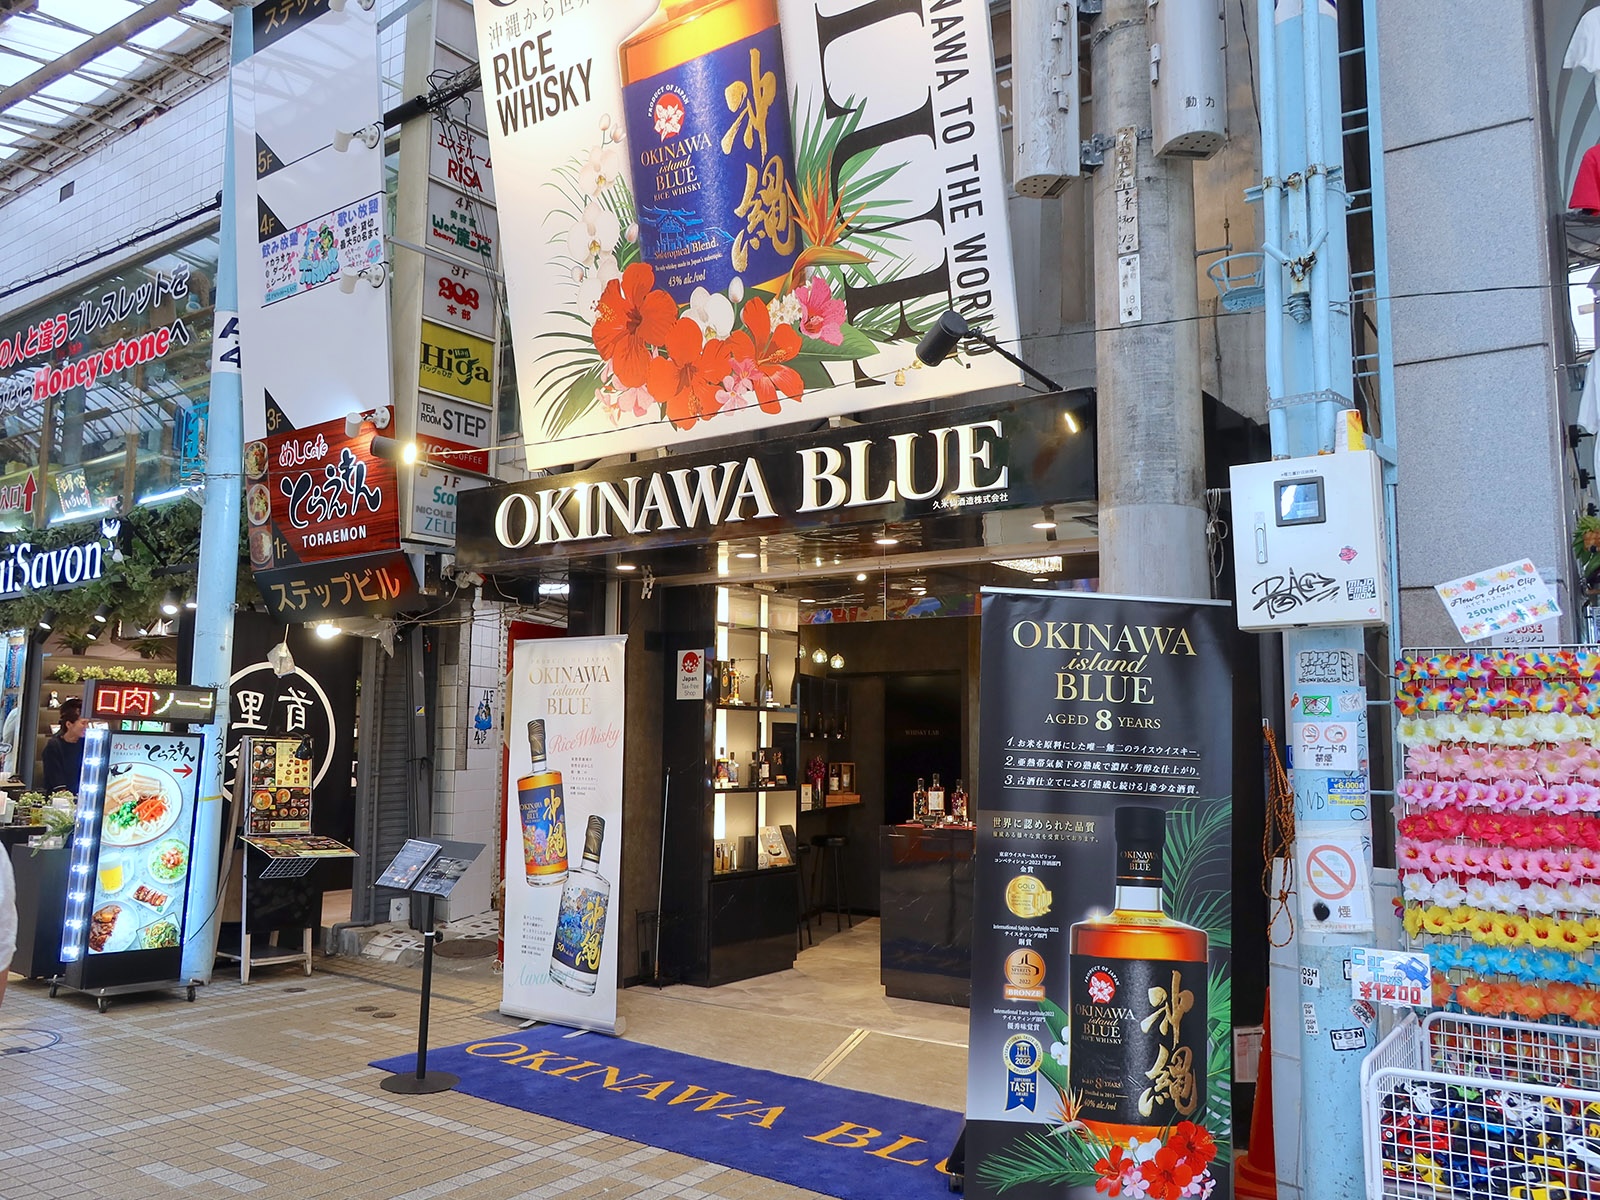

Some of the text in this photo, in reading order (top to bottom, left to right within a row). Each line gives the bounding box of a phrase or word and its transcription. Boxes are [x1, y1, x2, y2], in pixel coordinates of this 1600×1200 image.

[493, 29, 556, 96] RICE
[496, 57, 593, 137] WHISKY
[648, 84, 690, 118] PRODUCT OF JAPAN
[940, 97, 975, 145] TO
[459, 131, 476, 144] 5F
[640, 132, 713, 167] OKINAWA
[257, 151, 272, 174] 5F
[657, 153, 692, 176] island
[721, 48, 796, 273] 沖縄
[655, 165, 698, 192] BLUE
[945, 154, 984, 224] THE
[653, 181, 702, 202] RICE WHISKY
[337, 198, 378, 227] 歌い放題
[455, 197, 473, 210] 4F
[260, 214, 274, 235] 4F
[261, 231, 299, 258] 飲み放題
[691, 236, 719, 253] Blend.
[451, 265, 470, 279] 3F
[447, 304, 471, 321] 本部
[421, 341, 491, 385] Higa
[421, 402, 436, 414] TEA
[267, 408, 281, 431] 3F
[420, 412, 441, 426] ROOM
[442, 409, 487, 438] STEP
[452, 453, 483, 465] COFFEE
[443, 475, 461, 488] 1F
[494, 419, 1009, 550] OKINAWA BLUE
[416, 505, 453, 518] NICOLE
[933, 493, 1009, 510] 久米仙酒造株式会社
[302, 525, 366, 548] TORAEMON
[274, 538, 287, 559] 1F
[270, 567, 401, 612] ステップビル
[1450, 576, 1537, 608] Flower Hair Clip
[1012, 620, 1197, 656] OKINAWA
[1061, 652, 1148, 674] island
[529, 666, 610, 684] OKINAWA
[552, 684, 589, 696] island
[1054, 672, 1155, 705] BLUE
[547, 697, 592, 715] BLUE
[1044, 709, 1162, 731] AGED 8 YEARS
[1302, 744, 1347, 753] アーケード内
[1315, 753, 1333, 763] 禁煙
[993, 817, 1095, 833] 世界に認められた品質
[1130, 863, 1151, 871] BLUE
[1351, 948, 1385, 966] Car
[1084, 966, 1101, 983] PRODUCT
[1108, 968, 1121, 986] JAPAN
[1367, 967, 1402, 986] Toys
[1008, 988, 1042, 997] BRONZE
[1359, 981, 1421, 1005] ¥1200
[1074, 1003, 1136, 1020] OKINAWA
[1088, 1016, 1119, 1026] island
[1083, 1023, 1121, 1038] BLUE
[1094, 1037, 1122, 1045] WHISKY
[1138, 970, 1198, 1117] 沖縄
[1014, 1057, 1032, 1066] 2022
[1010, 1081, 1035, 1093] TASTE
[465, 1041, 964, 1177] OKINAWA BL
